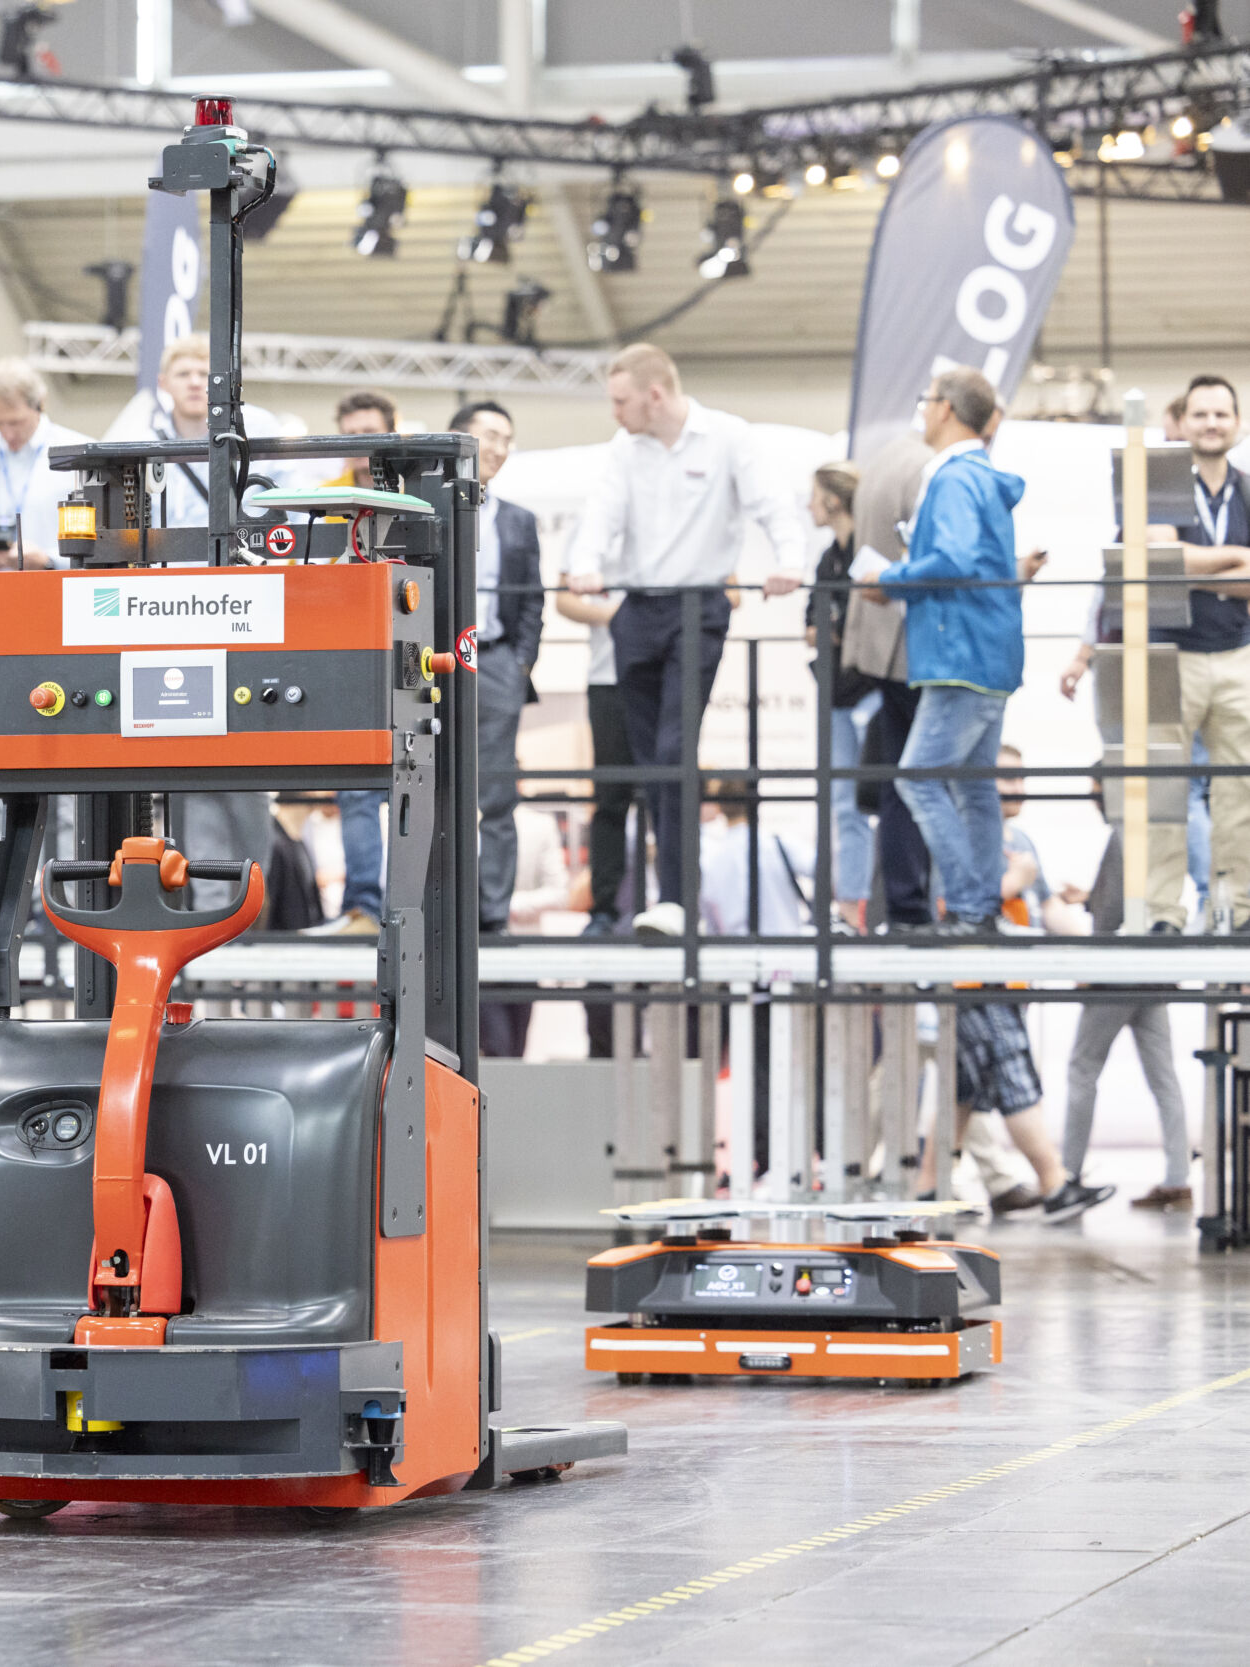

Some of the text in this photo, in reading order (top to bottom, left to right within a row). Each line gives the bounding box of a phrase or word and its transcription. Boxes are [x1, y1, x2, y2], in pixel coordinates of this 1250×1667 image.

[127, 594, 252, 616] Fraunhofer
[231, 622, 252, 633] IML
[206, 1142, 267, 1165] VL 01
